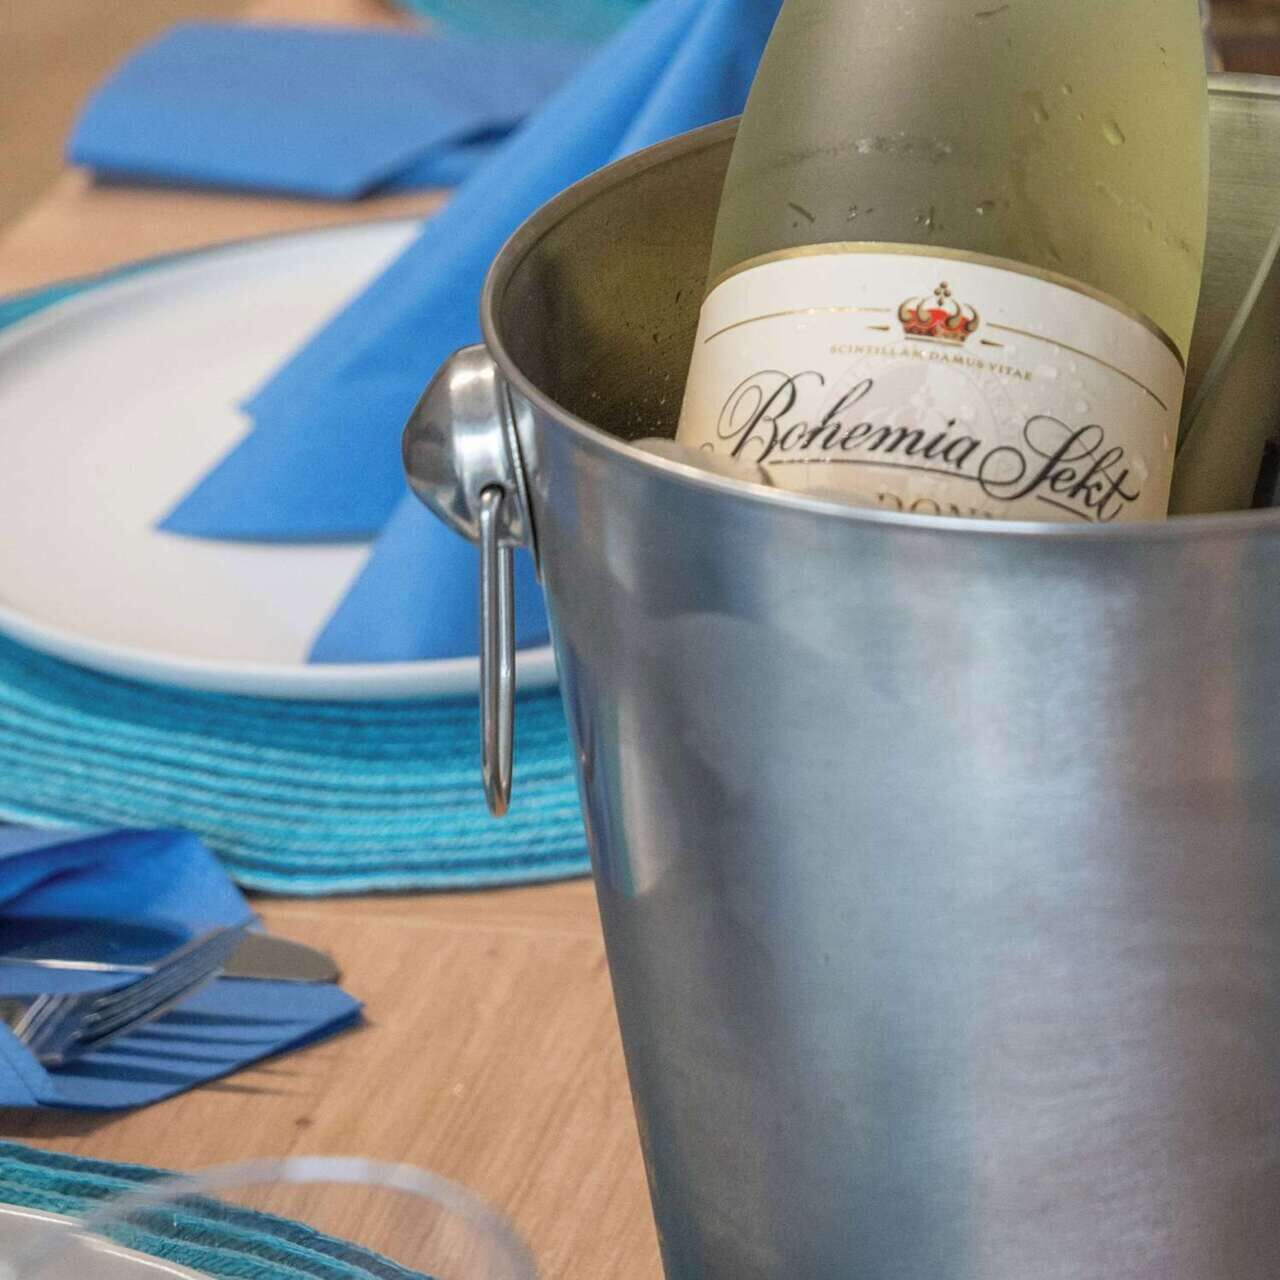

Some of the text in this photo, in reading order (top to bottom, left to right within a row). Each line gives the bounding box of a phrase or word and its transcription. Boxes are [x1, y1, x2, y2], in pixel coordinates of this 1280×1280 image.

[929, 350, 984, 370] DAMUS
[989, 364, 1034, 381] VITAE
[706, 369, 1140, 524] Bohemia Sekt
